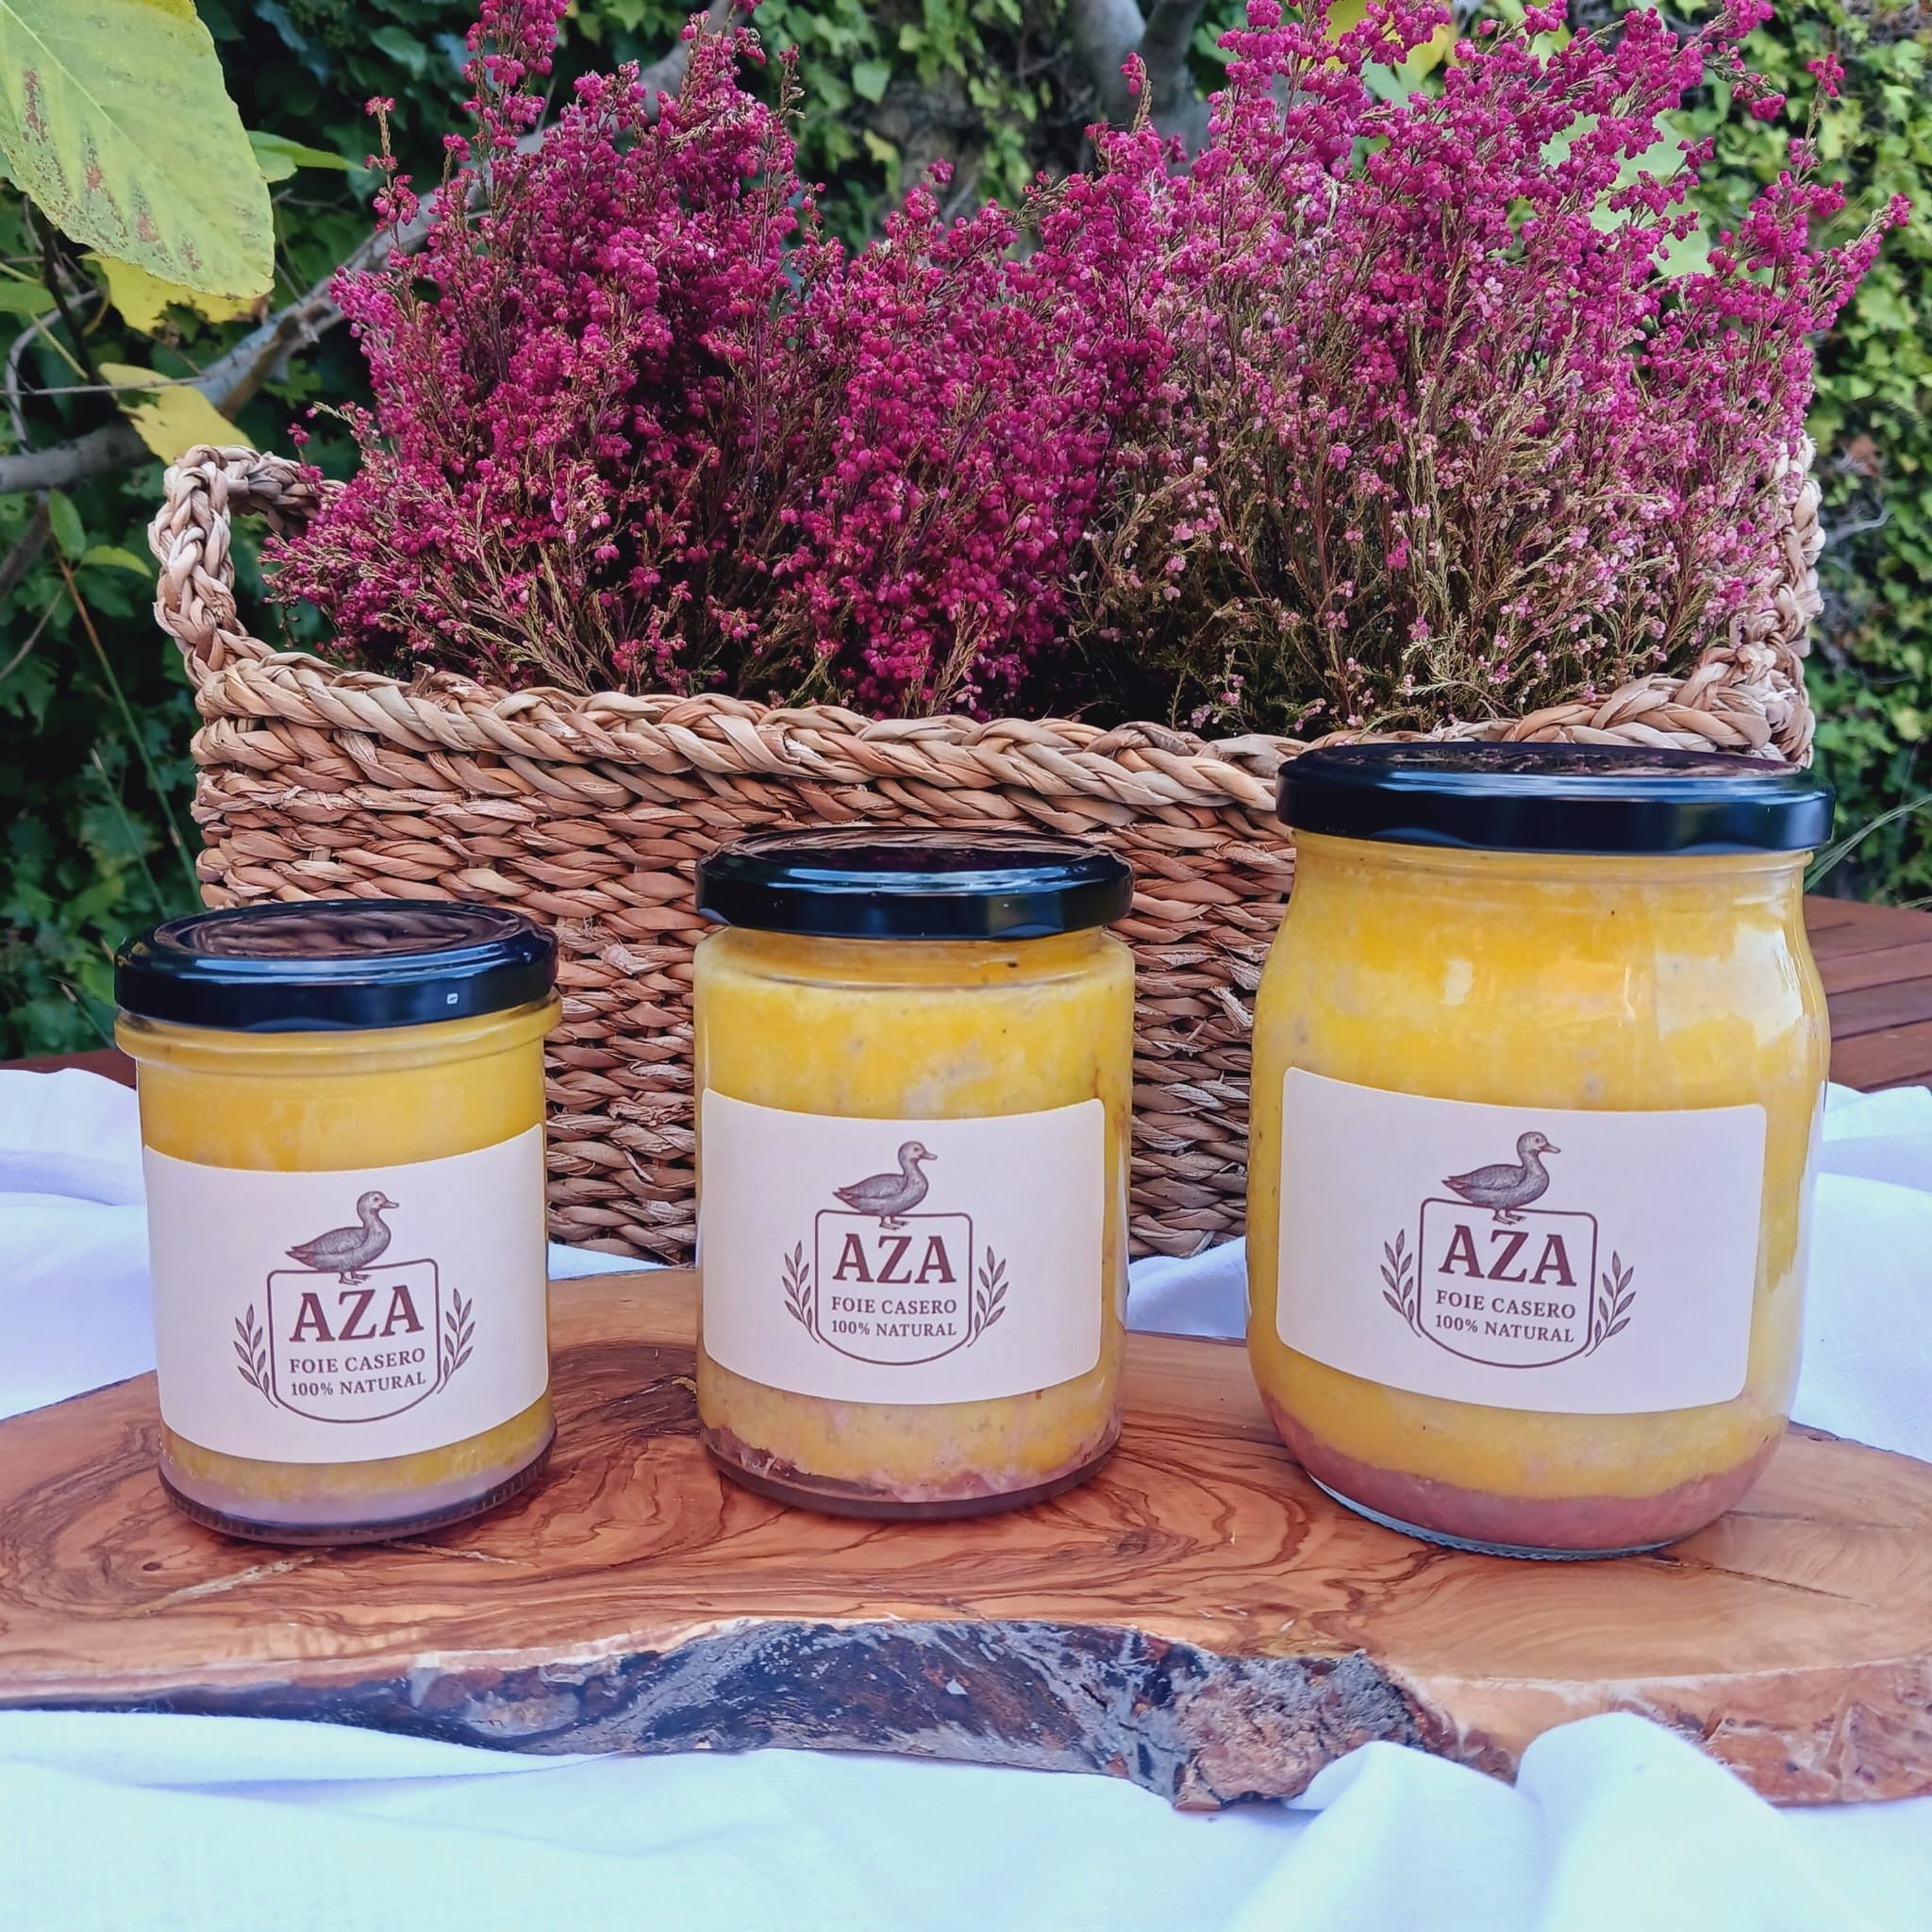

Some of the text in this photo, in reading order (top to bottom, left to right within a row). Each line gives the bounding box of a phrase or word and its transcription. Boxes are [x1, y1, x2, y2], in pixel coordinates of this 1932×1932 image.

[832, 1233, 958, 1284] AZA
[1438, 1224, 1577, 1287] AZA
[289, 1285, 425, 1342] AZA
[831, 1296, 958, 1314] FOIE CASERO
[1435, 1289, 1576, 1319] FOIE CASERO
[831, 1320, 958, 1337] 100% NATURAL
[1436, 1314, 1574, 1342] 100% NATURAL
[289, 1347, 425, 1374] FOIE CASERO
[291, 1371, 426, 1396] 100% NATURAL
